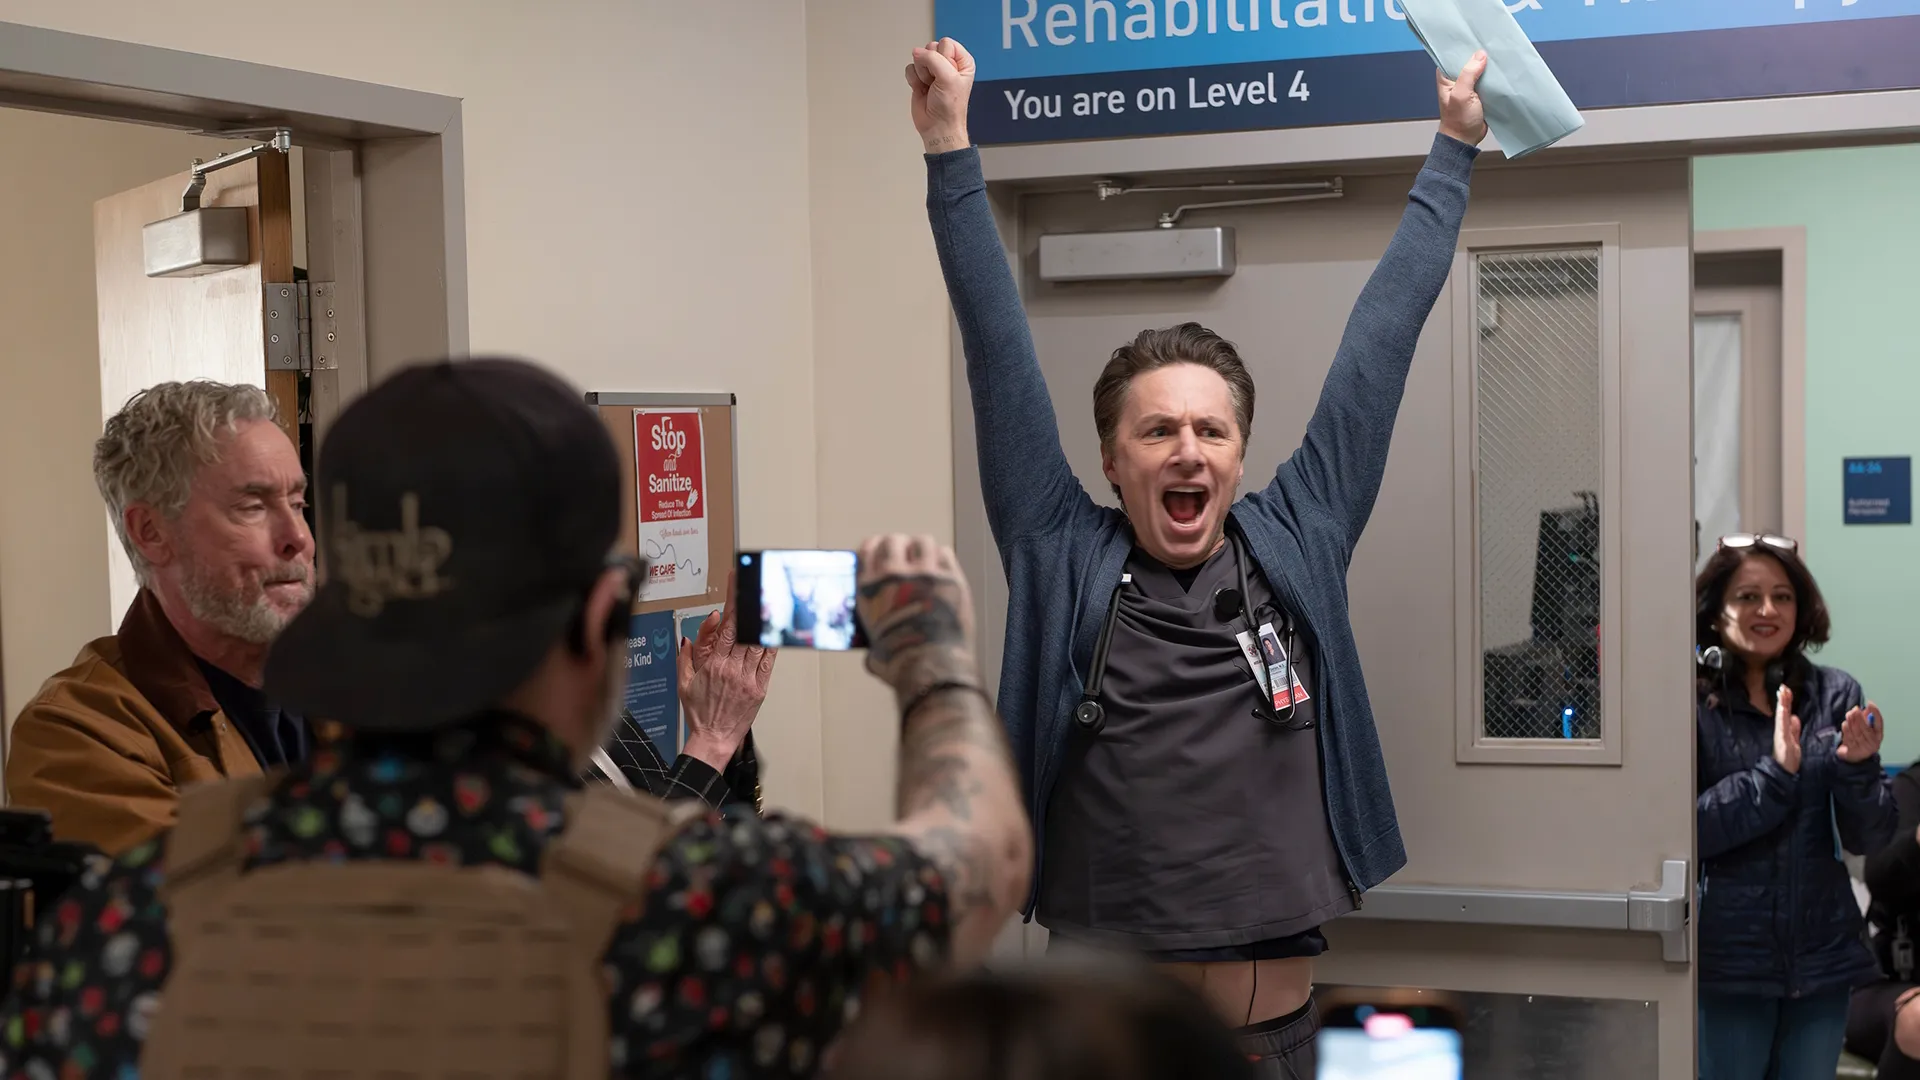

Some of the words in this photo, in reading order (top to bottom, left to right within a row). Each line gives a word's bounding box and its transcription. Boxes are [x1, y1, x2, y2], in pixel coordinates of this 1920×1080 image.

[1003, 89, 1062, 120] You
[1072, 90, 1126, 116] are
[1136, 86, 1176, 112] on
[1188, 72, 1278, 109] Level
[1288, 71, 1310, 102] 4
[651, 416, 686, 455] Stop
[663, 456, 677, 472] and
[648, 472, 692, 494] Sanitize
[649, 565, 659, 577] WE
[660, 563, 676, 576] CARE
[633, 651, 652, 667] Kind
[1274, 691, 1304, 707] PHYSAN
